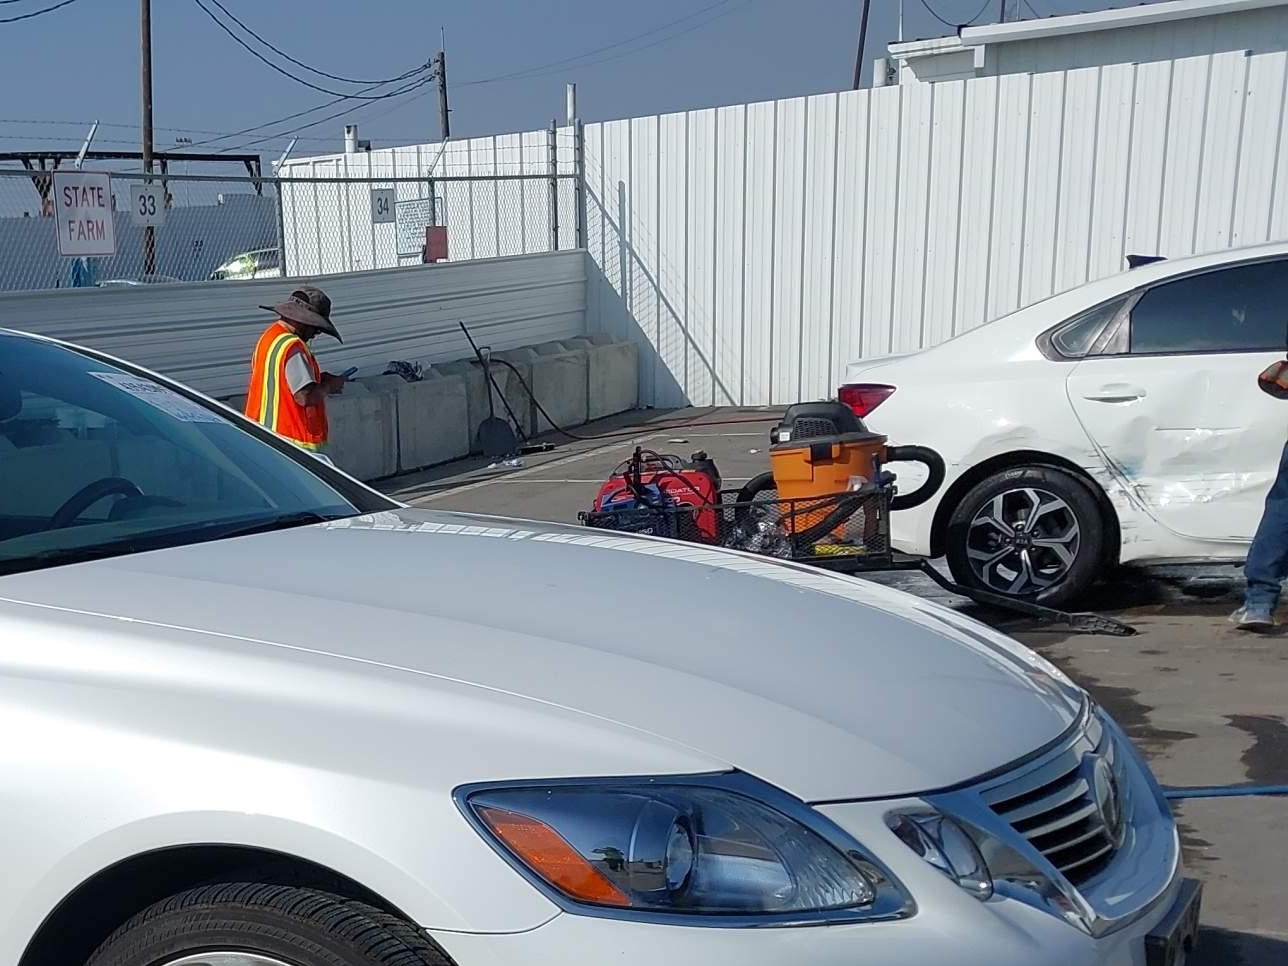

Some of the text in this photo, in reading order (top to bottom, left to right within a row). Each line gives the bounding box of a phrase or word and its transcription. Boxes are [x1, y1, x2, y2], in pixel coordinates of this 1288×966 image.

[63, 186, 105, 208] STATE
[138, 194, 157, 216] 33
[377, 197, 390, 215] 34
[68, 219, 106, 241] FARM
